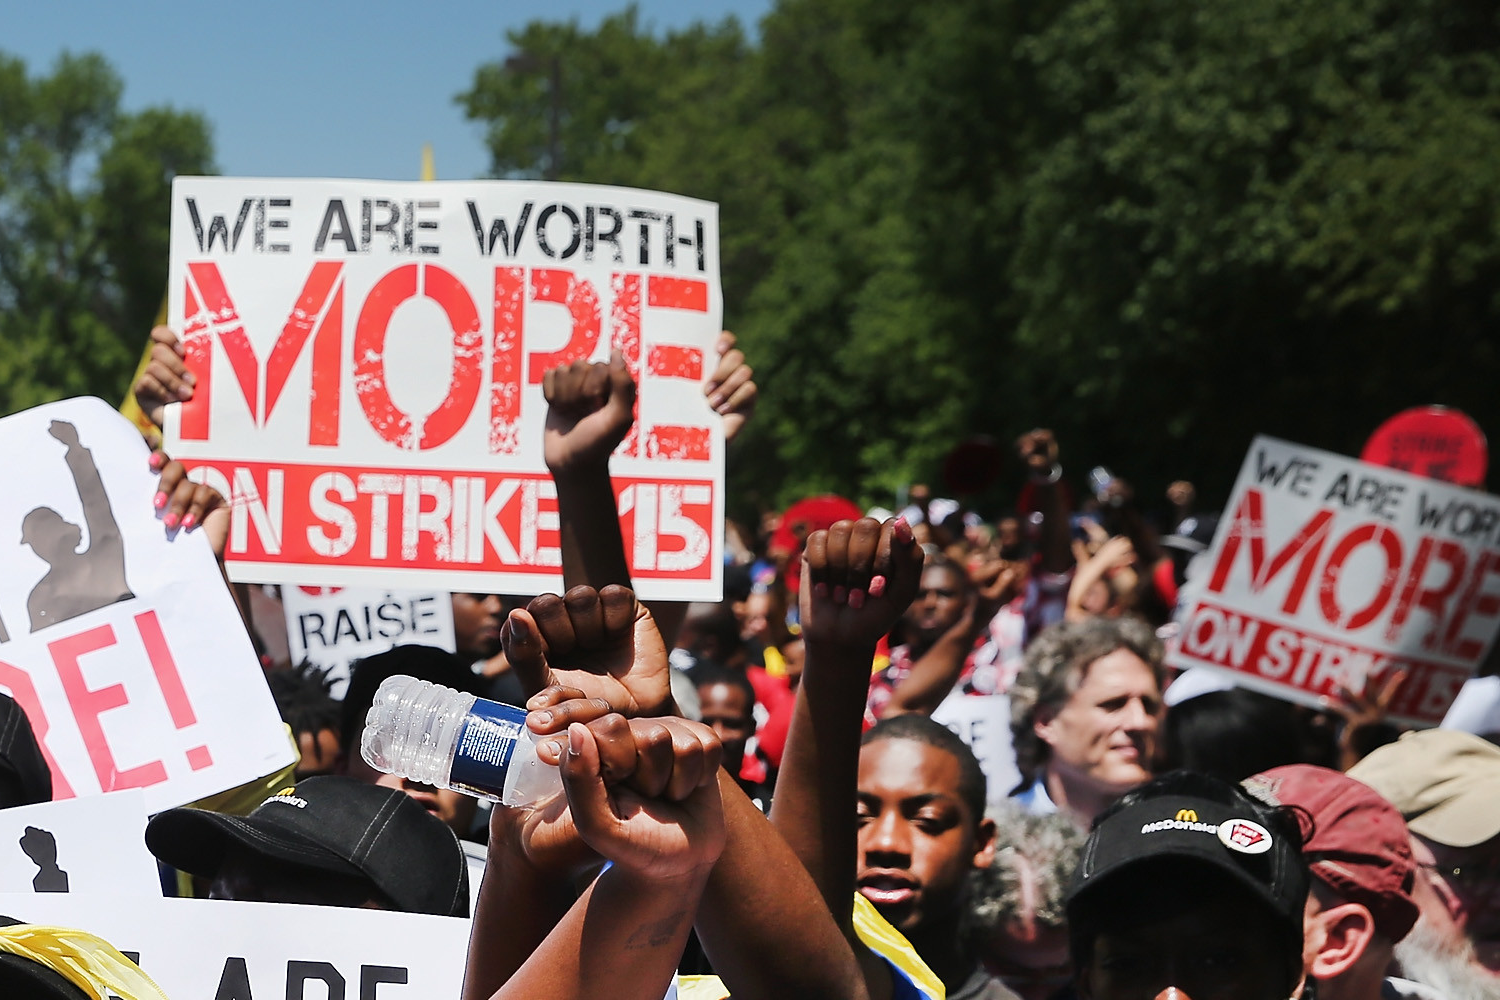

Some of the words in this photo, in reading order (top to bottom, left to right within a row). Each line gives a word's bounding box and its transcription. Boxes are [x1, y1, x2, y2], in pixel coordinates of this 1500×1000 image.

[186, 198, 292, 253] WE
[314, 199, 440, 254] ARE
[465, 200, 705, 271] WORTH
[180, 260, 710, 461] MORE
[307, 471, 562, 567] STRIKE
[1256, 449, 1320, 497] WE
[1324, 472, 1407, 521] ARE
[1418, 492, 1500, 547] WOR
[1209, 488, 1500, 663] MORE
[1187, 609, 1260, 668] ON
[1141, 819, 1218, 834] McDonald
